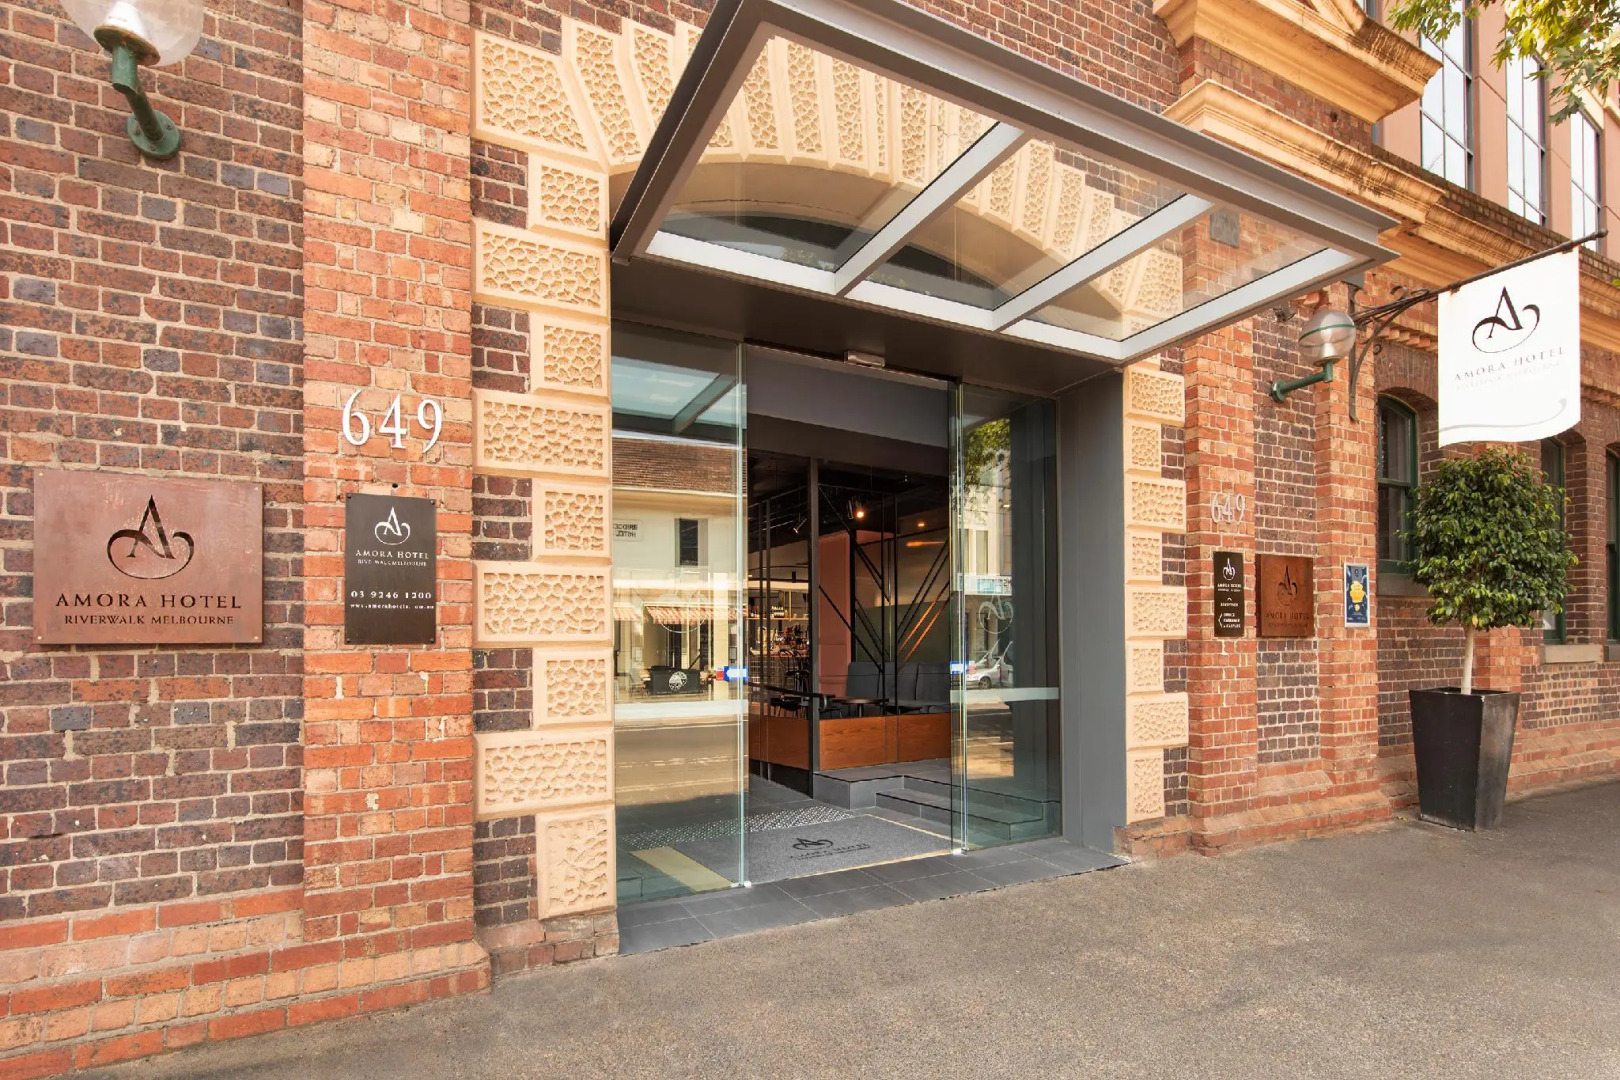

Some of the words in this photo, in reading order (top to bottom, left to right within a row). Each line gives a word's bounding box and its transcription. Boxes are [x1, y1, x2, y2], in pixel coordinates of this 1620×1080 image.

[1455, 362, 1507, 381] AMORA
[1514, 346, 1565, 366] HOTEL
[342, 389, 443, 454] 649
[1211, 492, 1246, 525] 649
[355, 549, 393, 558] AMORA
[397, 551, 429, 560] HOTEL
[55, 593, 147, 608] AMORA
[160, 594, 241, 609] HOTEL
[350, 590, 365, 599] 03
[370, 591, 399, 600] 9246
[405, 592, 432, 600] 1200
[65, 615, 145, 625] RIVERWALK
[151, 615, 234, 625] MELBOURNE
